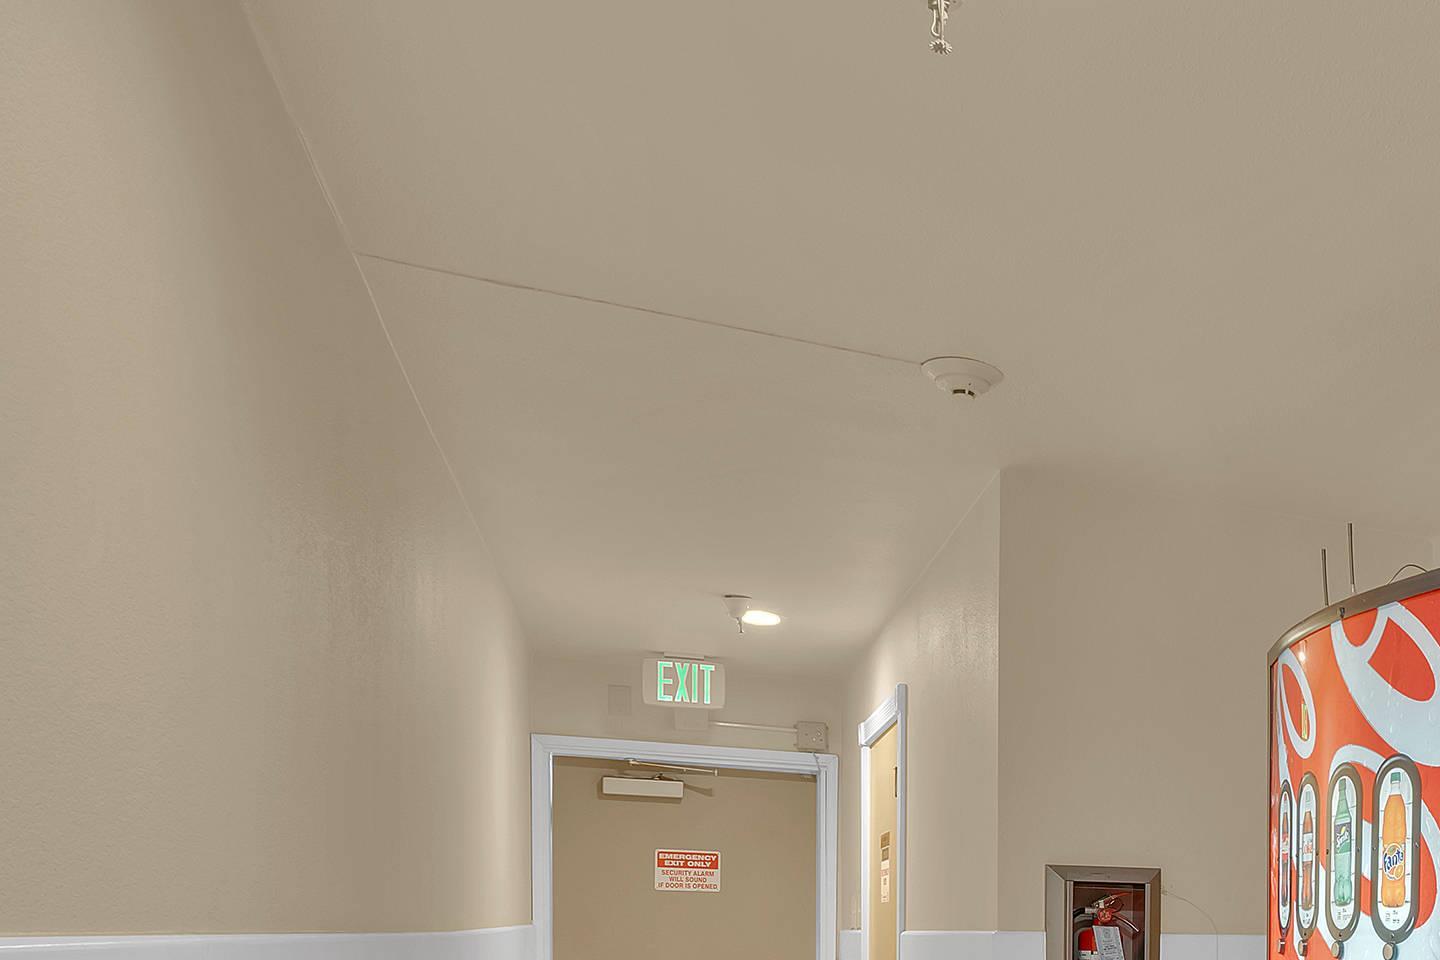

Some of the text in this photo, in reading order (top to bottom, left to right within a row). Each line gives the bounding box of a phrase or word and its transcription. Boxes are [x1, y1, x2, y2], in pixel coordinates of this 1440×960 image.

[657, 660, 715, 705] EXIT
[659, 853, 717, 861] EMERGENCY
[1384, 848, 1404, 873] Fanta
